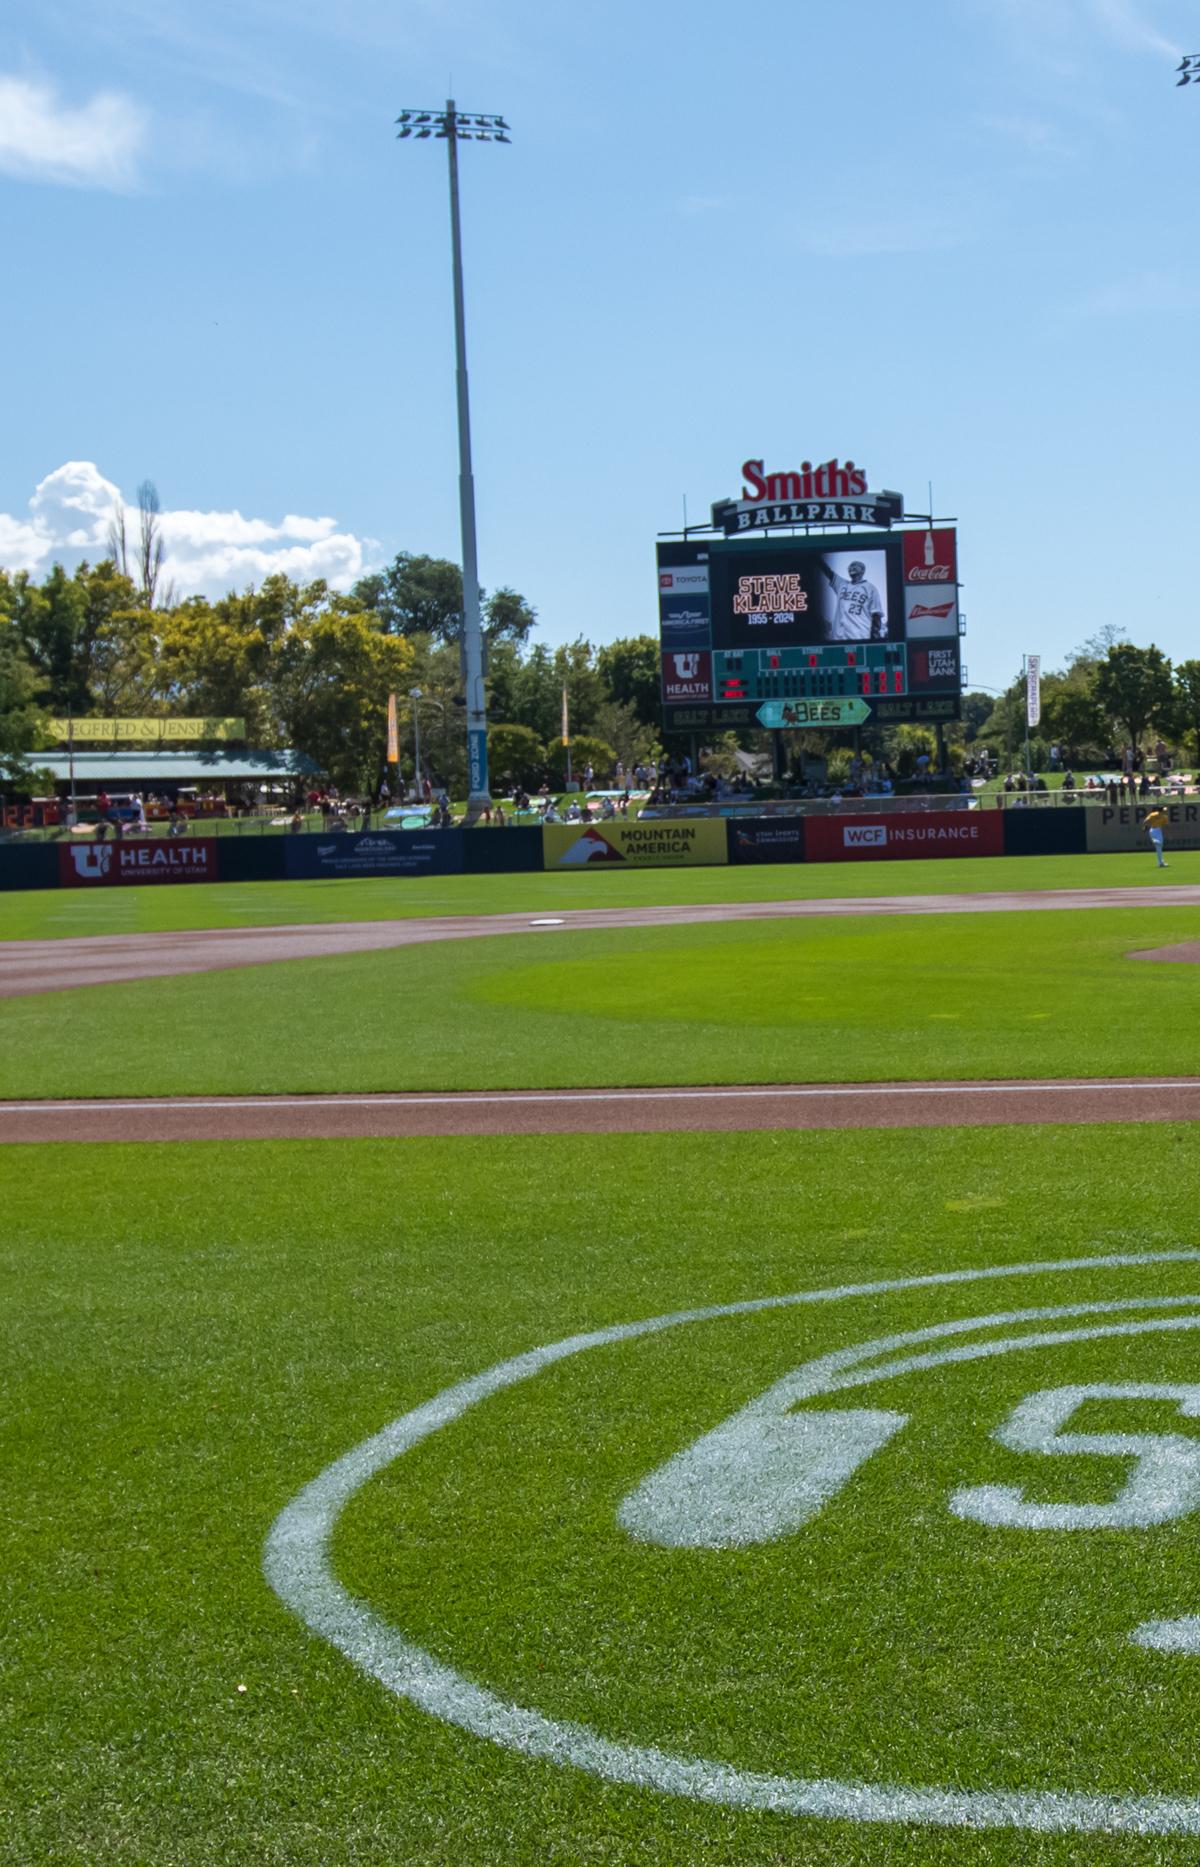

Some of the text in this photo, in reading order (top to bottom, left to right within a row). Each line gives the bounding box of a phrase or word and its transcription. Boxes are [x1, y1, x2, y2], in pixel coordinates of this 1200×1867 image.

[742, 458, 867, 502] Smith's
[738, 504, 876, 529] BALLPARK
[738, 573, 801, 594] STEVE
[733, 592, 808, 613] KLAUKE
[848, 603, 862, 615] 23
[774, 613, 794, 624] 2024
[929, 650, 952, 659] FIRST
[929, 659, 955, 668] UTAH
[929, 667, 956, 676] BANK
[667, 683, 709, 694] HEALTH
[712, 708, 749, 723] LAKE
[795, 702, 841, 723] BEES
[877, 700, 954, 717] SALT LAKE
[55, 722, 216, 738] SIEGFRIED & JENSEN
[470, 733, 480, 789] FORD ZONE
[621, 828, 695, 842] MOUNTAIN
[848, 827, 979, 842] WCF INSURANCE
[626, 842, 691, 854] AMERICA
[121, 848, 206, 866] HEALTH
[121, 868, 170, 876] UNIVERSITY
[185, 866, 207, 874] UTAH
